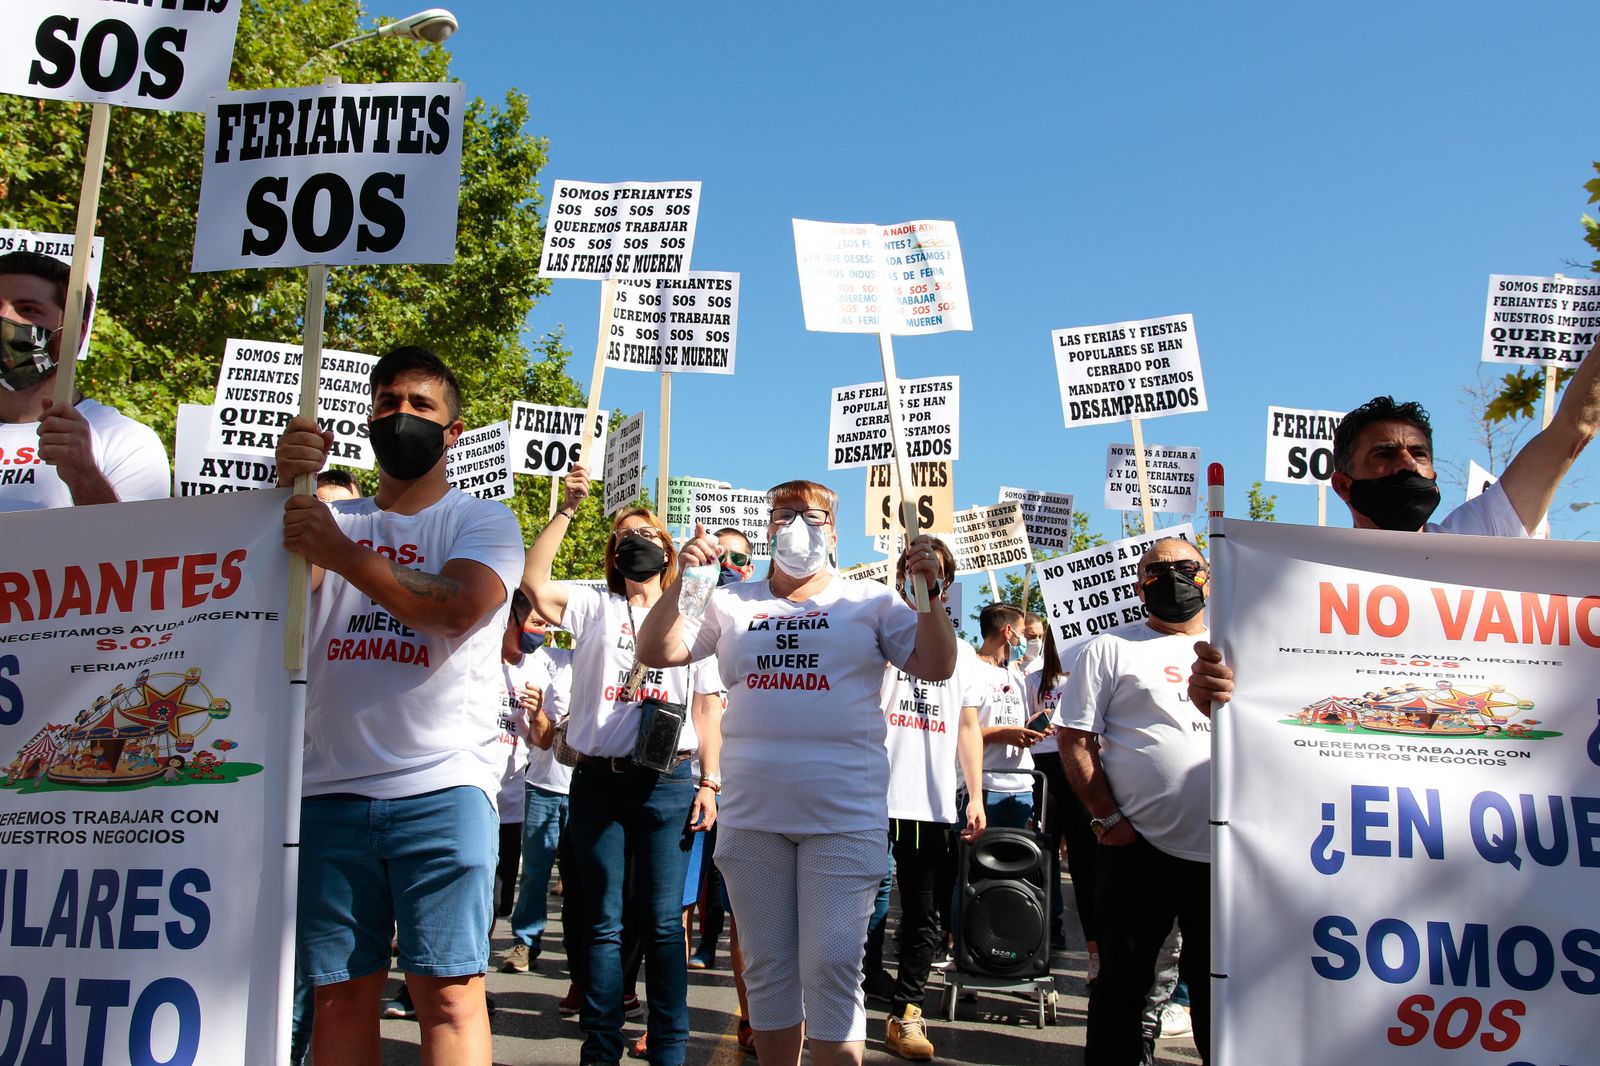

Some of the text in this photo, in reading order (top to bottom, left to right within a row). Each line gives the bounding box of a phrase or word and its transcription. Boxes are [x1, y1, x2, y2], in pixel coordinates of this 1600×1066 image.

[29, 15, 187, 100] SOS
[215, 95, 450, 164] FERIANTES
[559, 187, 693, 200] SOMOS FERIANTES
[241, 172, 406, 257] SOS
[557, 204, 690, 217] SOS SOS SOS SOS
[554, 220, 688, 233] QUEREMOS TRABAJAR
[890, 224, 916, 236] NADIE
[18, 239, 28, 251] A
[550, 236, 685, 250] SOS SOS SOS SOS
[546, 253, 683, 274] LAS FERIAS SE MUEREN
[906, 251, 945, 264] ESTAMOS
[903, 271, 915, 281] DE
[656, 278, 732, 291] FERIANTES
[910, 284, 927, 295] SOS
[1499, 281, 1538, 292] SOMOS
[639, 294, 732, 308] SOS SOS SOS
[1493, 296, 1569, 310] FERIANTES Y
[912, 305, 930, 315] SOS
[670, 312, 730, 325] TRABAJAR
[906, 315, 943, 327] MUEREN
[1493, 312, 1554, 325] NUESTROS
[636, 328, 729, 343] SOS SOS SOS
[1059, 321, 1188, 347] LAS FERIAS Y FIESTAS
[235, 348, 280, 364] SOMOS
[623, 343, 728, 368] FERIAS SE MUEREN
[1069, 338, 1183, 362] POPULARES SE HAN
[1087, 357, 1170, 377] CERRADO POR
[227, 367, 299, 386] FERIANTES
[1068, 371, 1194, 396] MANDATO Y ESTAMOS
[225, 387, 293, 404] NUESTROS
[837, 382, 953, 402] LAS Y FIESTAS
[907, 396, 946, 408] SE HAN
[1069, 387, 1199, 421] DESAMPARADOS
[515, 407, 602, 438] FERIANTS
[909, 411, 931, 422] POR
[836, 428, 887, 444] MANDATO
[457, 440, 505, 460] Y PAGAMOS
[1111, 447, 1123, 456] NO
[1162, 450, 1188, 459] DEJAR
[457, 454, 505, 475] IMPUESTOS
[1116, 470, 1123, 478] Y
[1110, 483, 1122, 492] EN
[695, 493, 728, 502] SOMOS
[1005, 491, 1069, 505] SOMOS EMPRESARIOS
[695, 505, 759, 515] SOS SOS SOS
[987, 505, 1017, 518] FIESTAS
[1043, 506, 1070, 516] PAGAMOS
[999, 516, 1015, 526] HAN
[1035, 514, 1068, 526] IMPUESTOS
[955, 529, 1008, 545] CERRADO POR
[989, 537, 1023, 550] ESTAMOS
[1044, 548, 1128, 580] NO VAMOS A
[1072, 570, 1116, 591] NADIE
[1064, 599, 1074, 615] Y
[1081, 589, 1109, 610] LOS
[1319, 582, 1410, 638] NO
[130, 620, 185, 634] AYUDA
[188, 611, 279, 625] URGENTE
[748, 618, 829, 631] LA FERIA
[1060, 622, 1082, 640] EN
[1086, 611, 1119, 636] QUE
[96, 633, 173, 651] S.O.S
[776, 633, 799, 650] SE
[327, 637, 430, 668] GRANADA
[1279, 648, 1405, 658] NECESITAMOS
[1477, 657, 1563, 666] URGENTE
[757, 653, 819, 670] MUERE
[1380, 659, 1460, 668] S.O.S
[746, 672, 830, 691] GRANADA
[913, 687, 928, 700] SE
[899, 699, 939, 716] MUERE
[889, 713, 946, 734] GRANADA
[1294, 739, 1531, 759] QUEREMOS TRABAJAR CON
[1319, 749, 1507, 767] NUESTROS NEGOCIOS
[72, 810, 219, 824] TRABAJAR CON
[92, 829, 185, 844] NEGOCIOS
[1310, 785, 1600, 876] ¿EN QUE
[1311, 915, 1600, 996] SOMOS
[1387, 994, 1526, 1053] SOS
